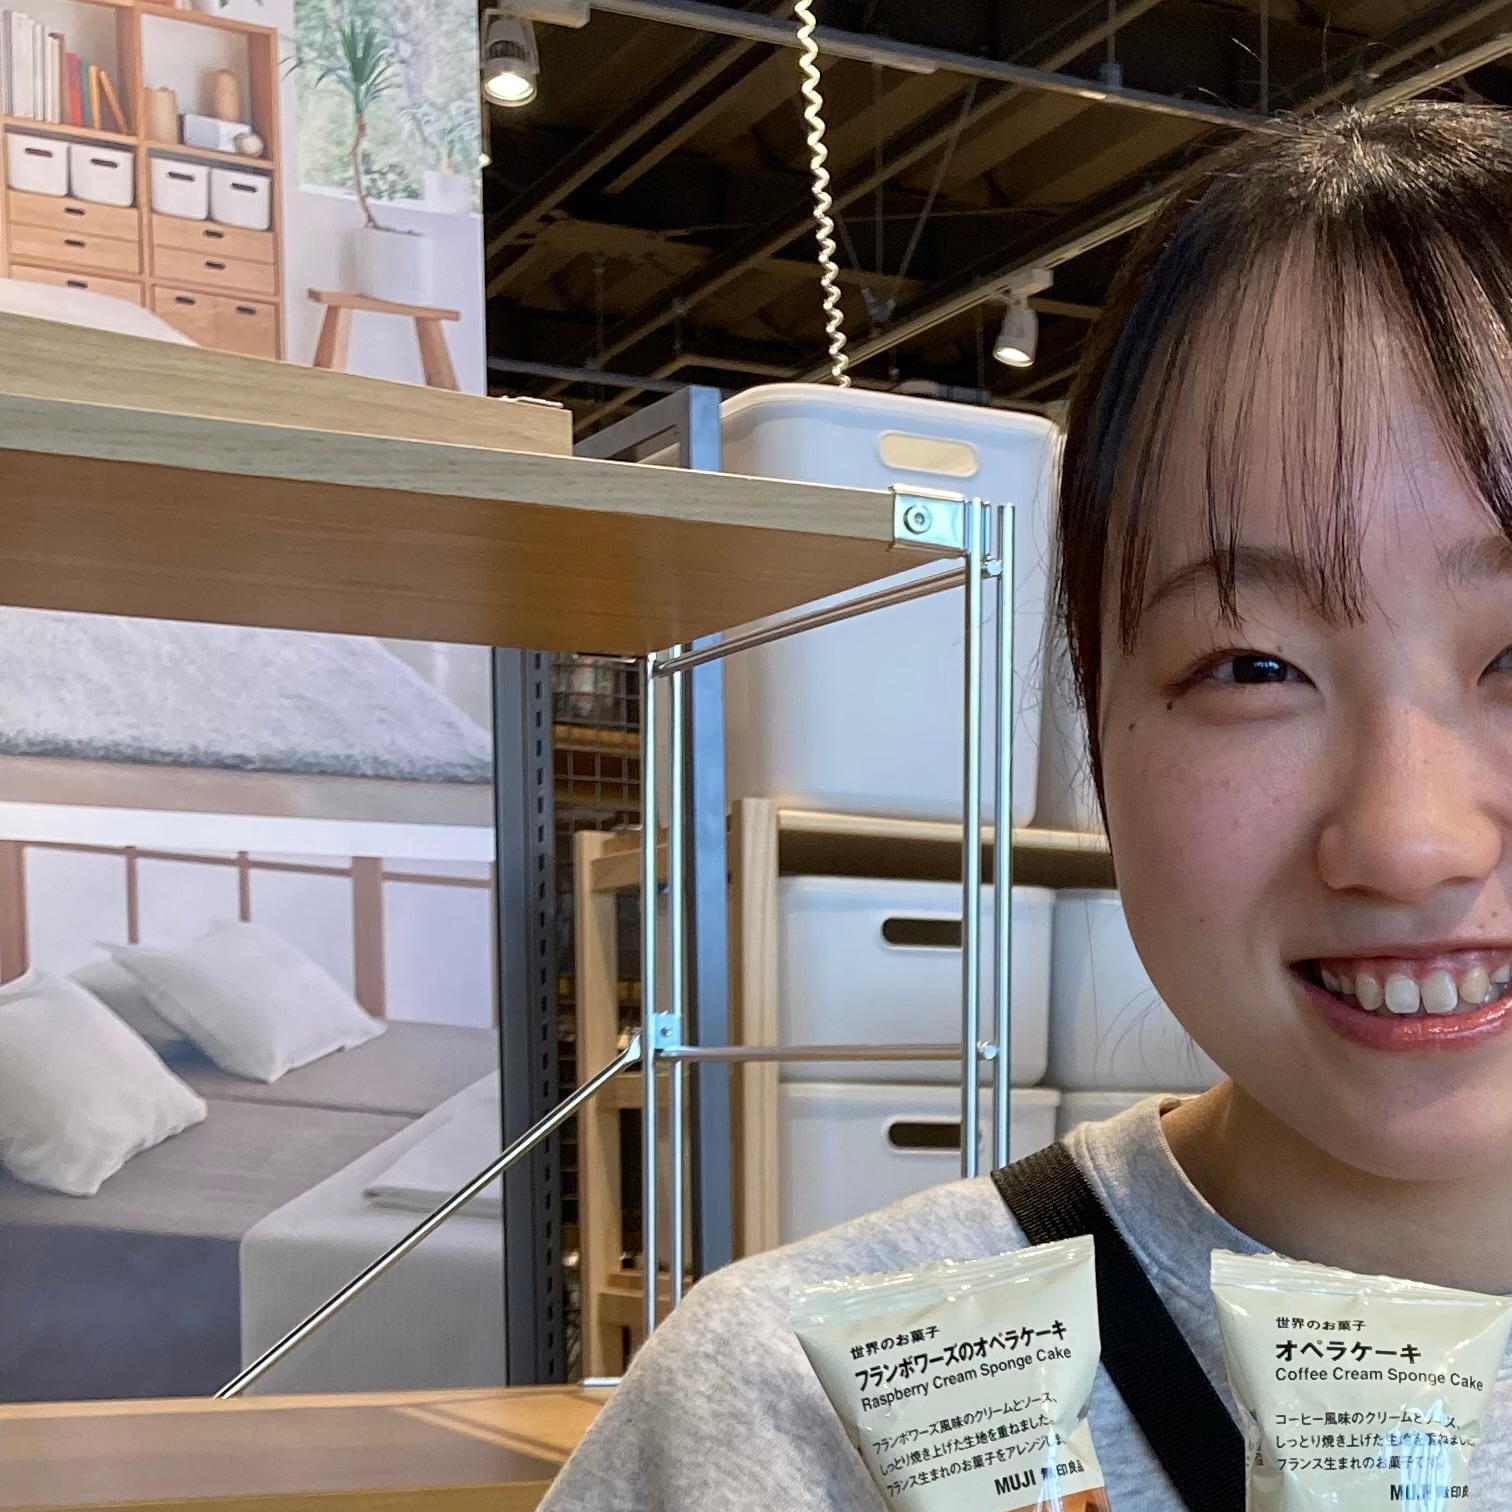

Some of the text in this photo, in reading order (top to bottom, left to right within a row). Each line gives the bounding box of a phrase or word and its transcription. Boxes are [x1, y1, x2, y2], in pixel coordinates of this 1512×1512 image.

[1275, 1316, 1367, 1332] 世界のお菓子
[850, 1325, 941, 1360] 世界のお菓子
[855, 1319, 1067, 1391] フランボワーズのオペラケーキ
[1275, 1340, 1422, 1364] オペラケーキ
[861, 1346, 1072, 1412] Raspberry Cream Sponge Cake
[1275, 1367, 1484, 1391] Coffee Cream Sponge Cake
[994, 1469, 1037, 1496] MUJI
[1390, 1484, 1431, 1501] MUJI
